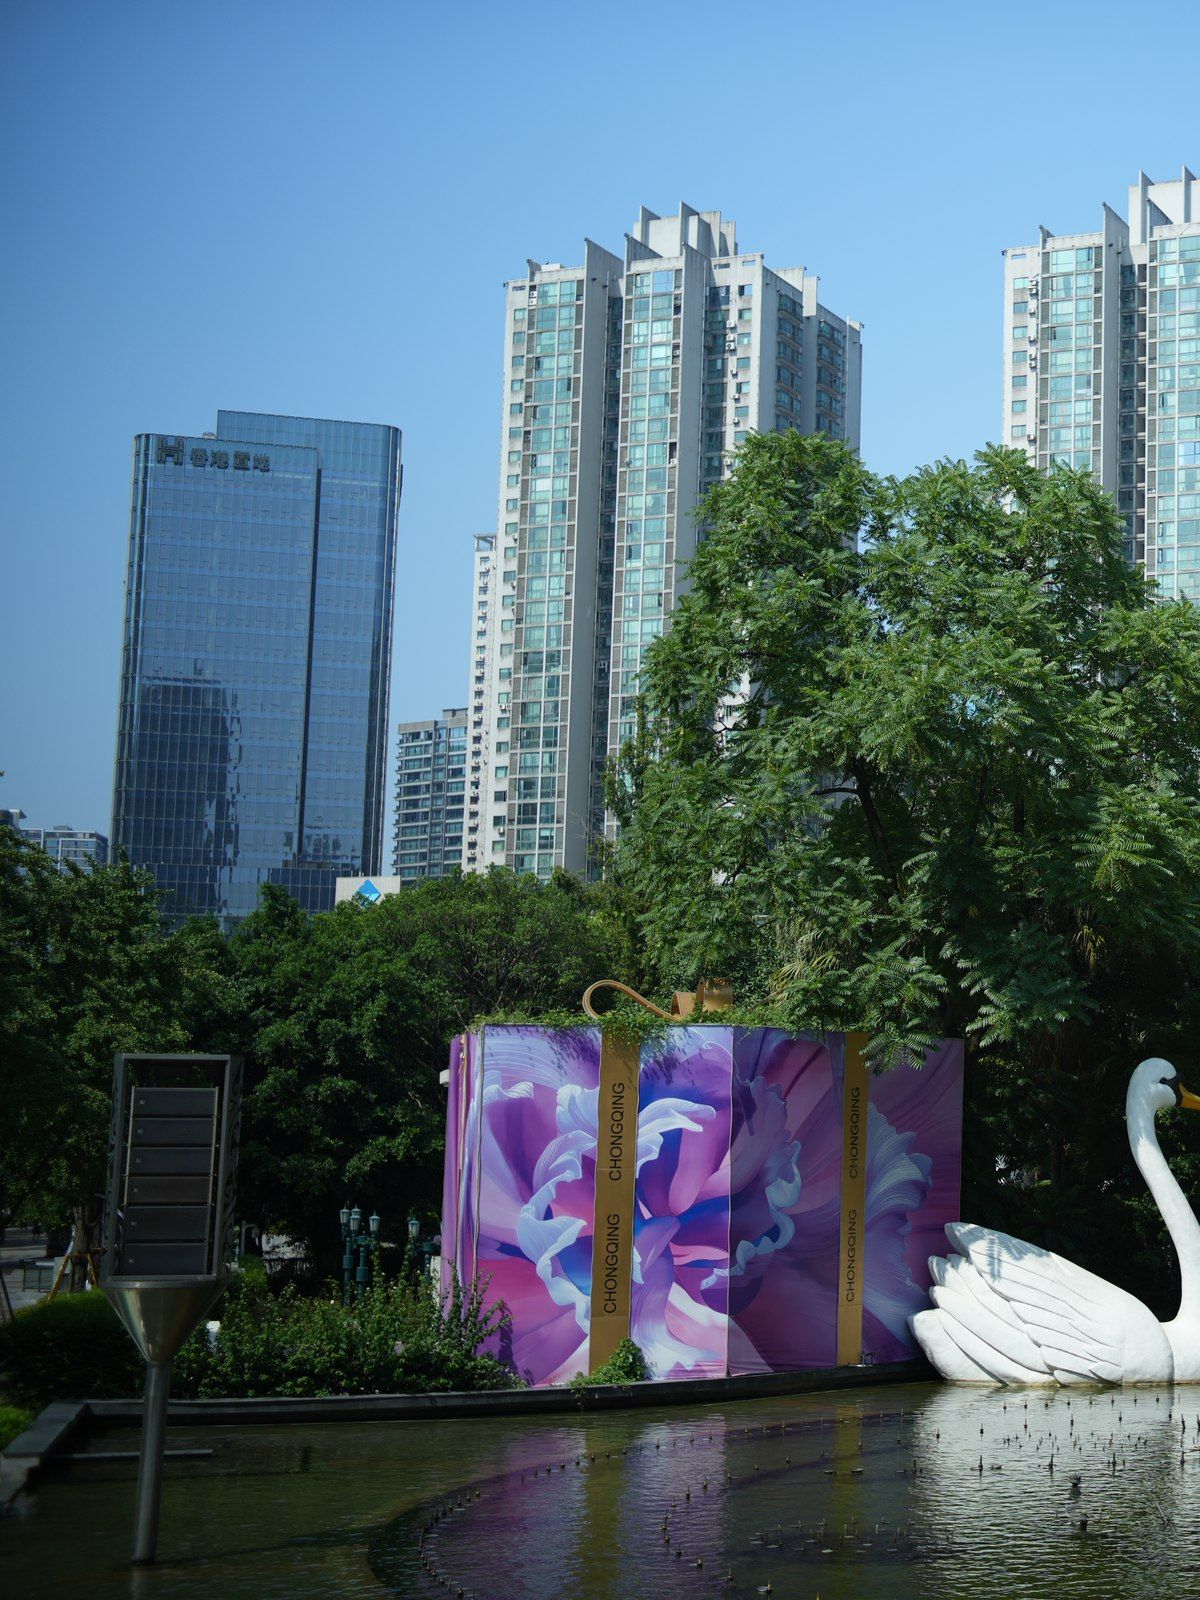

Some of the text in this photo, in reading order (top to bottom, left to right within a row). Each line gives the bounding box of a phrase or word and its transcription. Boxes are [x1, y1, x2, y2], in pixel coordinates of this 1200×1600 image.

[190, 448, 271, 473] 香港置地
[608, 1082, 625, 1181] CHONGQING
[849, 1087, 860, 1179] CHONGQING
[603, 1214, 620, 1314] CHONGQING
[845, 1209, 857, 1302] CHONGQING
